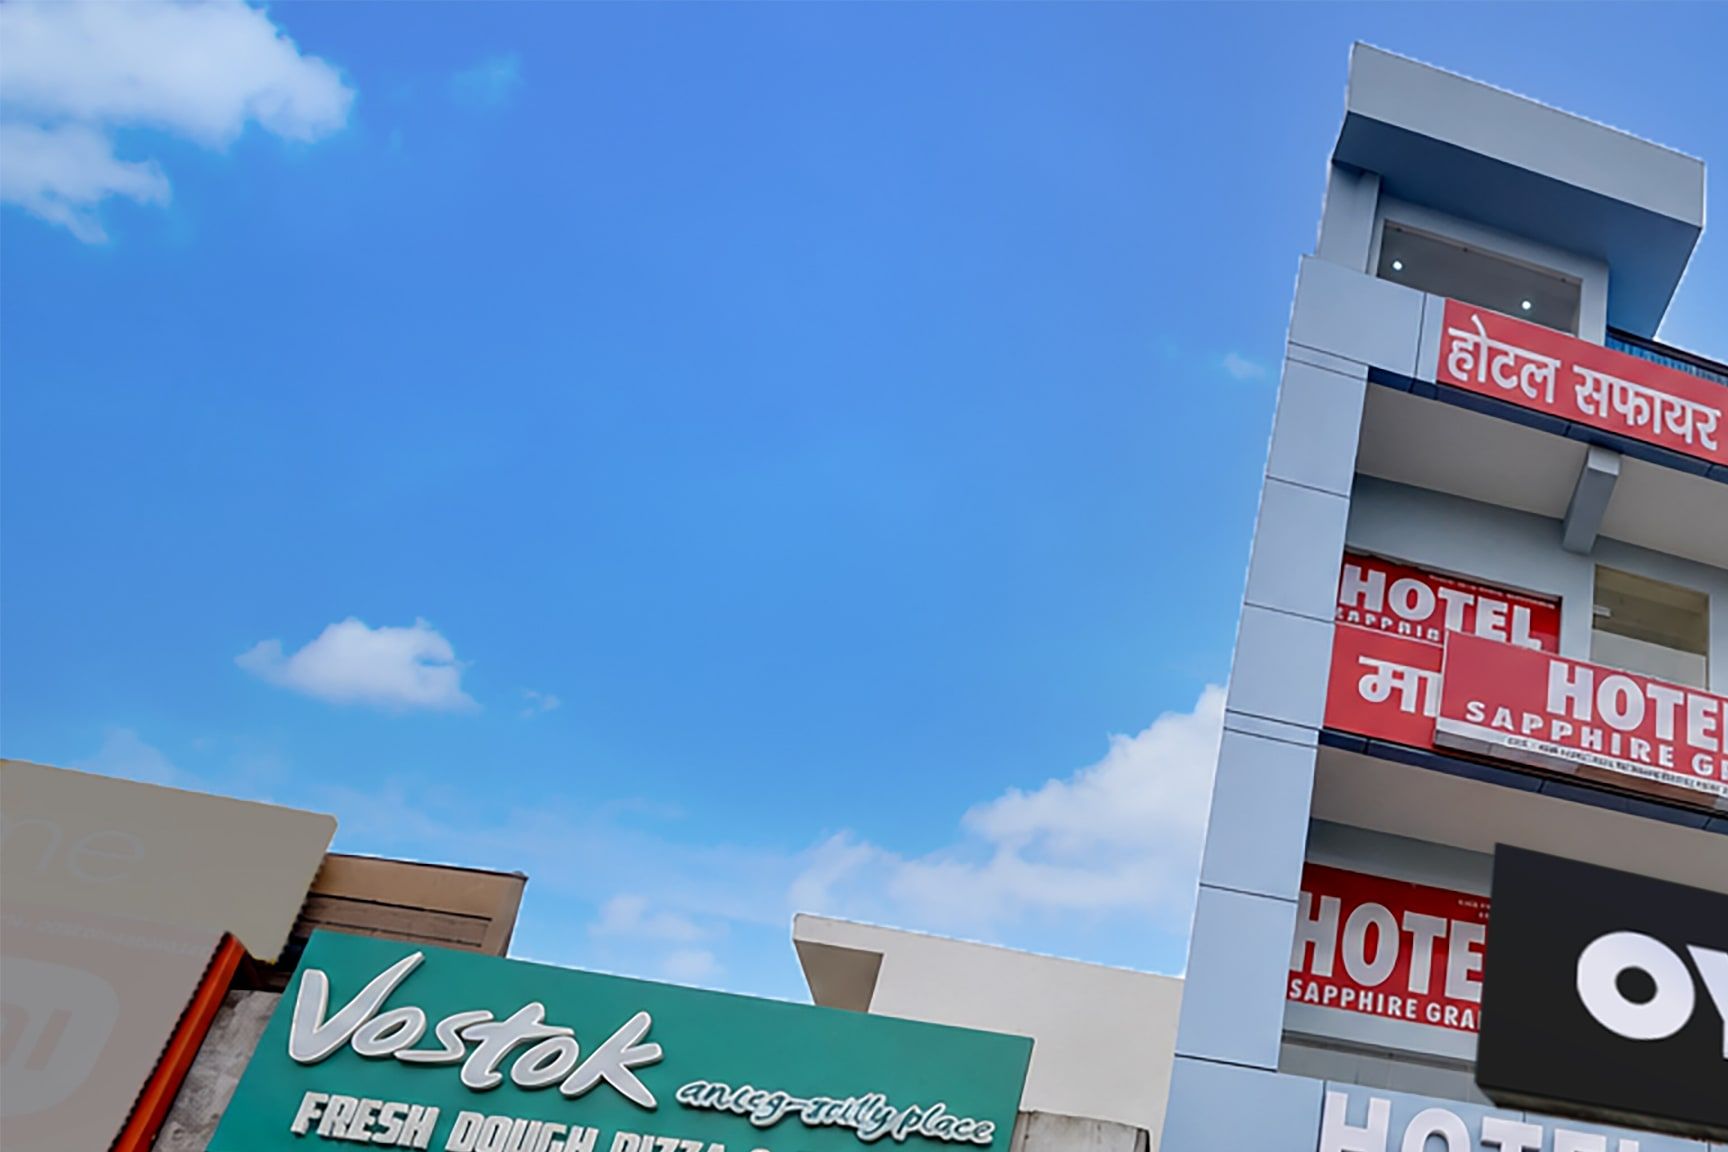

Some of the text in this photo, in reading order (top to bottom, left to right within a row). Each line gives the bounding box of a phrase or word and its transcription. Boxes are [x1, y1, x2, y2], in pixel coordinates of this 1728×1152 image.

[1447, 315, 1560, 404] होटल
[1573, 365, 1720, 451] सफायर
[1339, 563, 1542, 651] HOTEL
[1466, 700, 1674, 767] SAPPHIRE
[1289, 891, 1486, 1002] HOTE
[288, 950, 664, 1110] Vostok
[1289, 978, 1482, 1030] SAPPHIRE GRA
[290, 1091, 440, 1151] FRESH
[891, 1103, 996, 1145] place
